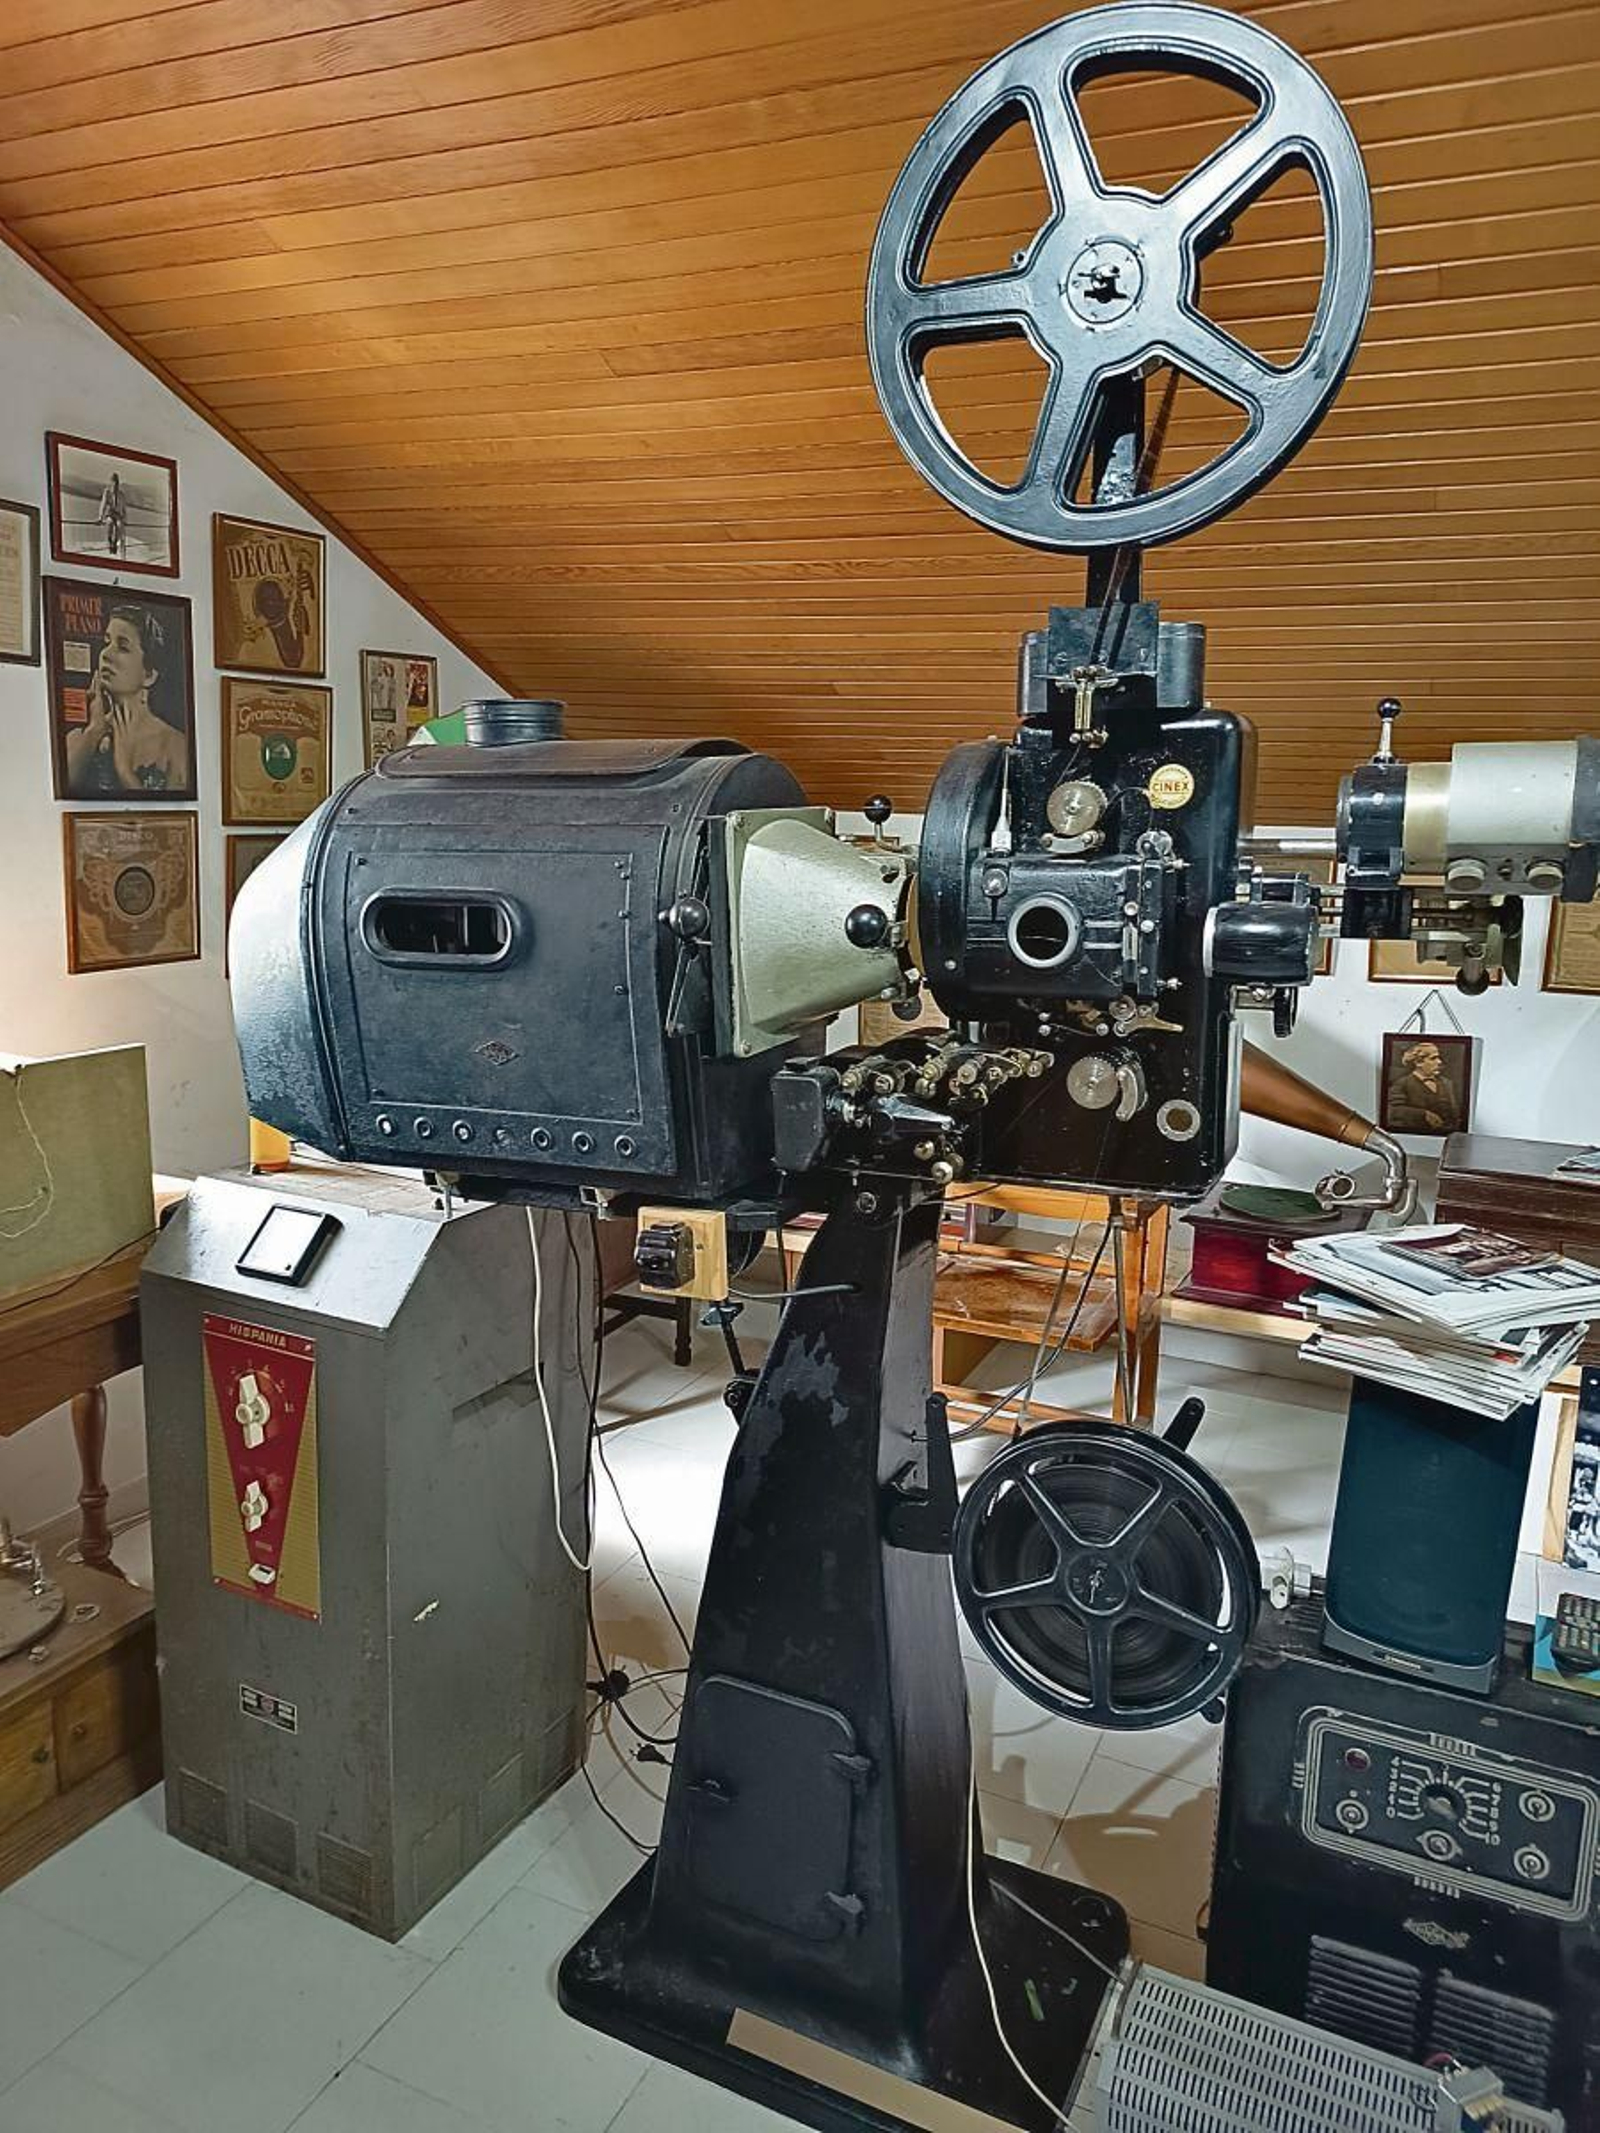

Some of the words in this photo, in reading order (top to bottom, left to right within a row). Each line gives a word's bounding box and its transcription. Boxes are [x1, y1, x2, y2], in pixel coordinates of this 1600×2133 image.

[229, 543, 290, 580] DECCA
[1152, 781, 1190, 792] CINEX
[228, 1323, 287, 1347] HISPANIA
[1390, 1768, 1398, 1779] 3
[1389, 1781, 1398, 1792] 2
[1492, 1782, 1502, 1793] 6
[1491, 1794, 1501, 1805] 7
[1386, 1806, 1396, 1818] 0
[1490, 1807, 1500, 1819] 8
[1485, 1832, 1501, 1846] 10
